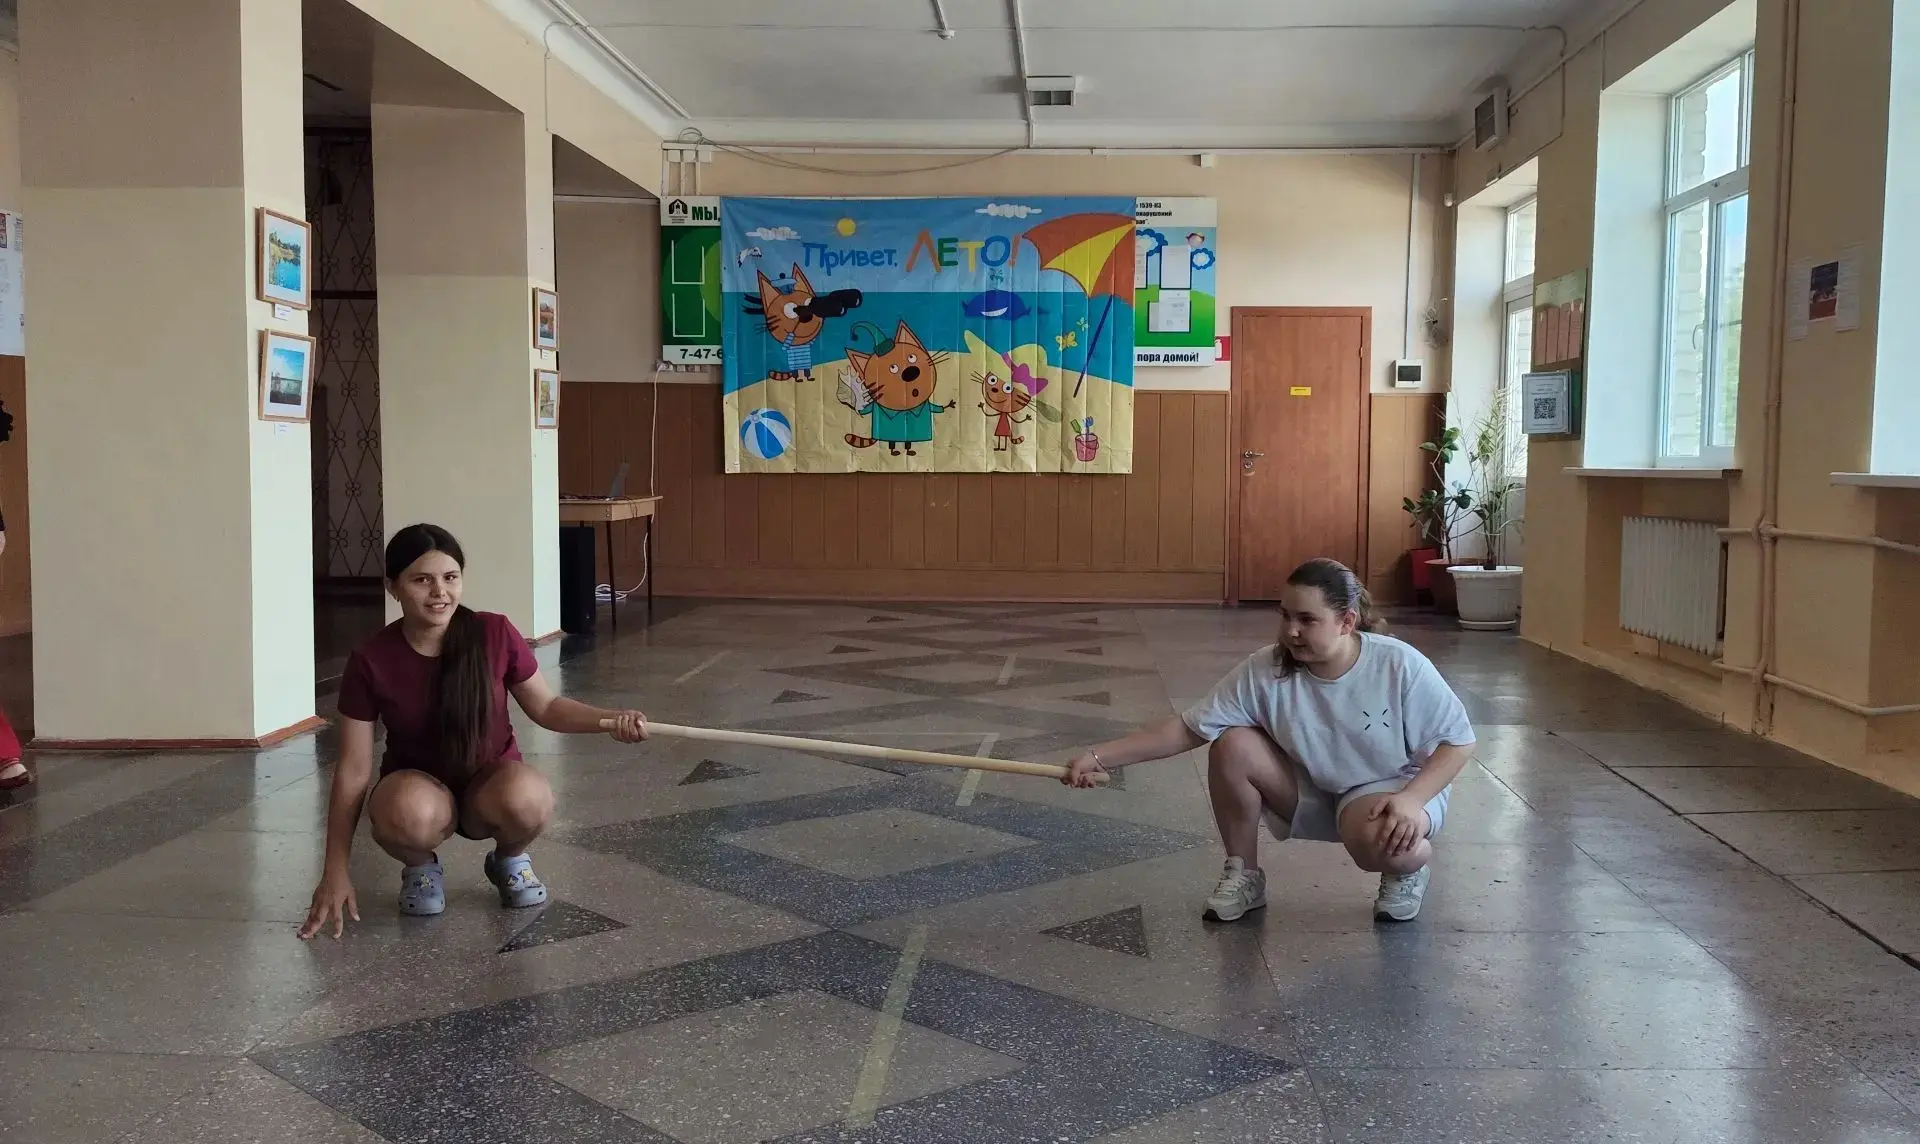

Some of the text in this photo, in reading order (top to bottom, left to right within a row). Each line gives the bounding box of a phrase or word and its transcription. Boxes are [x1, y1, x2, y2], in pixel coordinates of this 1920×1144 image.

[691, 206, 721, 222] МЫ,
[905, 229, 1020, 272] ЛЕТО!
[1136, 351, 1199, 364] пора домой!
